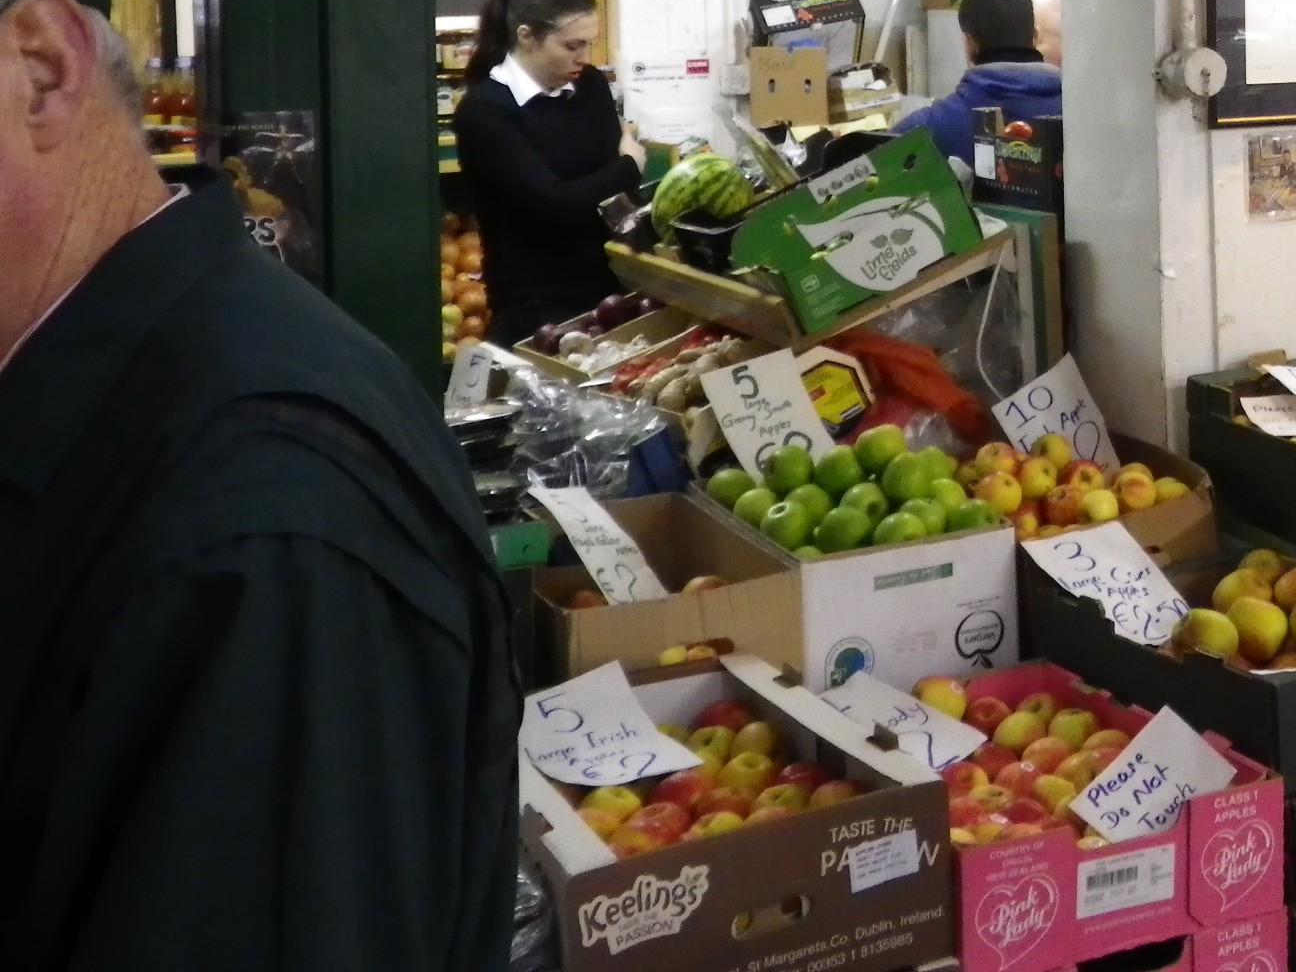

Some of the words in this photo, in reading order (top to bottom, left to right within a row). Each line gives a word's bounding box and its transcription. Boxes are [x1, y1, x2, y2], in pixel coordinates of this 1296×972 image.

[860, 246, 894, 280] Lime
[878, 245, 917, 281] Fields
[731, 364, 759, 399] 5
[1005, 386, 1053, 429] 10
[1054, 541, 1097, 572] 3
[536, 693, 584, 733] 5
[583, 722, 637, 748] Irish
[1087, 752, 1149, 808] Please
[1100, 807, 1130, 829] Do
[1133, 764, 1169, 805] Not
[1138, 783, 1196, 829] Touch
[1214, 791, 1250, 809] CLASS
[1253, 789, 1259, 800] 1
[1214, 805, 1257, 824] APPLES
[829, 819, 876, 843] TASTE
[882, 816, 913, 833] THE
[1213, 830, 1257, 876] Pink
[1220, 852, 1264, 890] Lady
[583, 880, 698, 942] Keelings
[991, 885, 1039, 935] Pink
[999, 906, 1046, 949] Lady
[616, 918, 674, 947] PASSION
[1217, 925, 1254, 943] CLASS
[1217, 939, 1260, 958] APPLES
